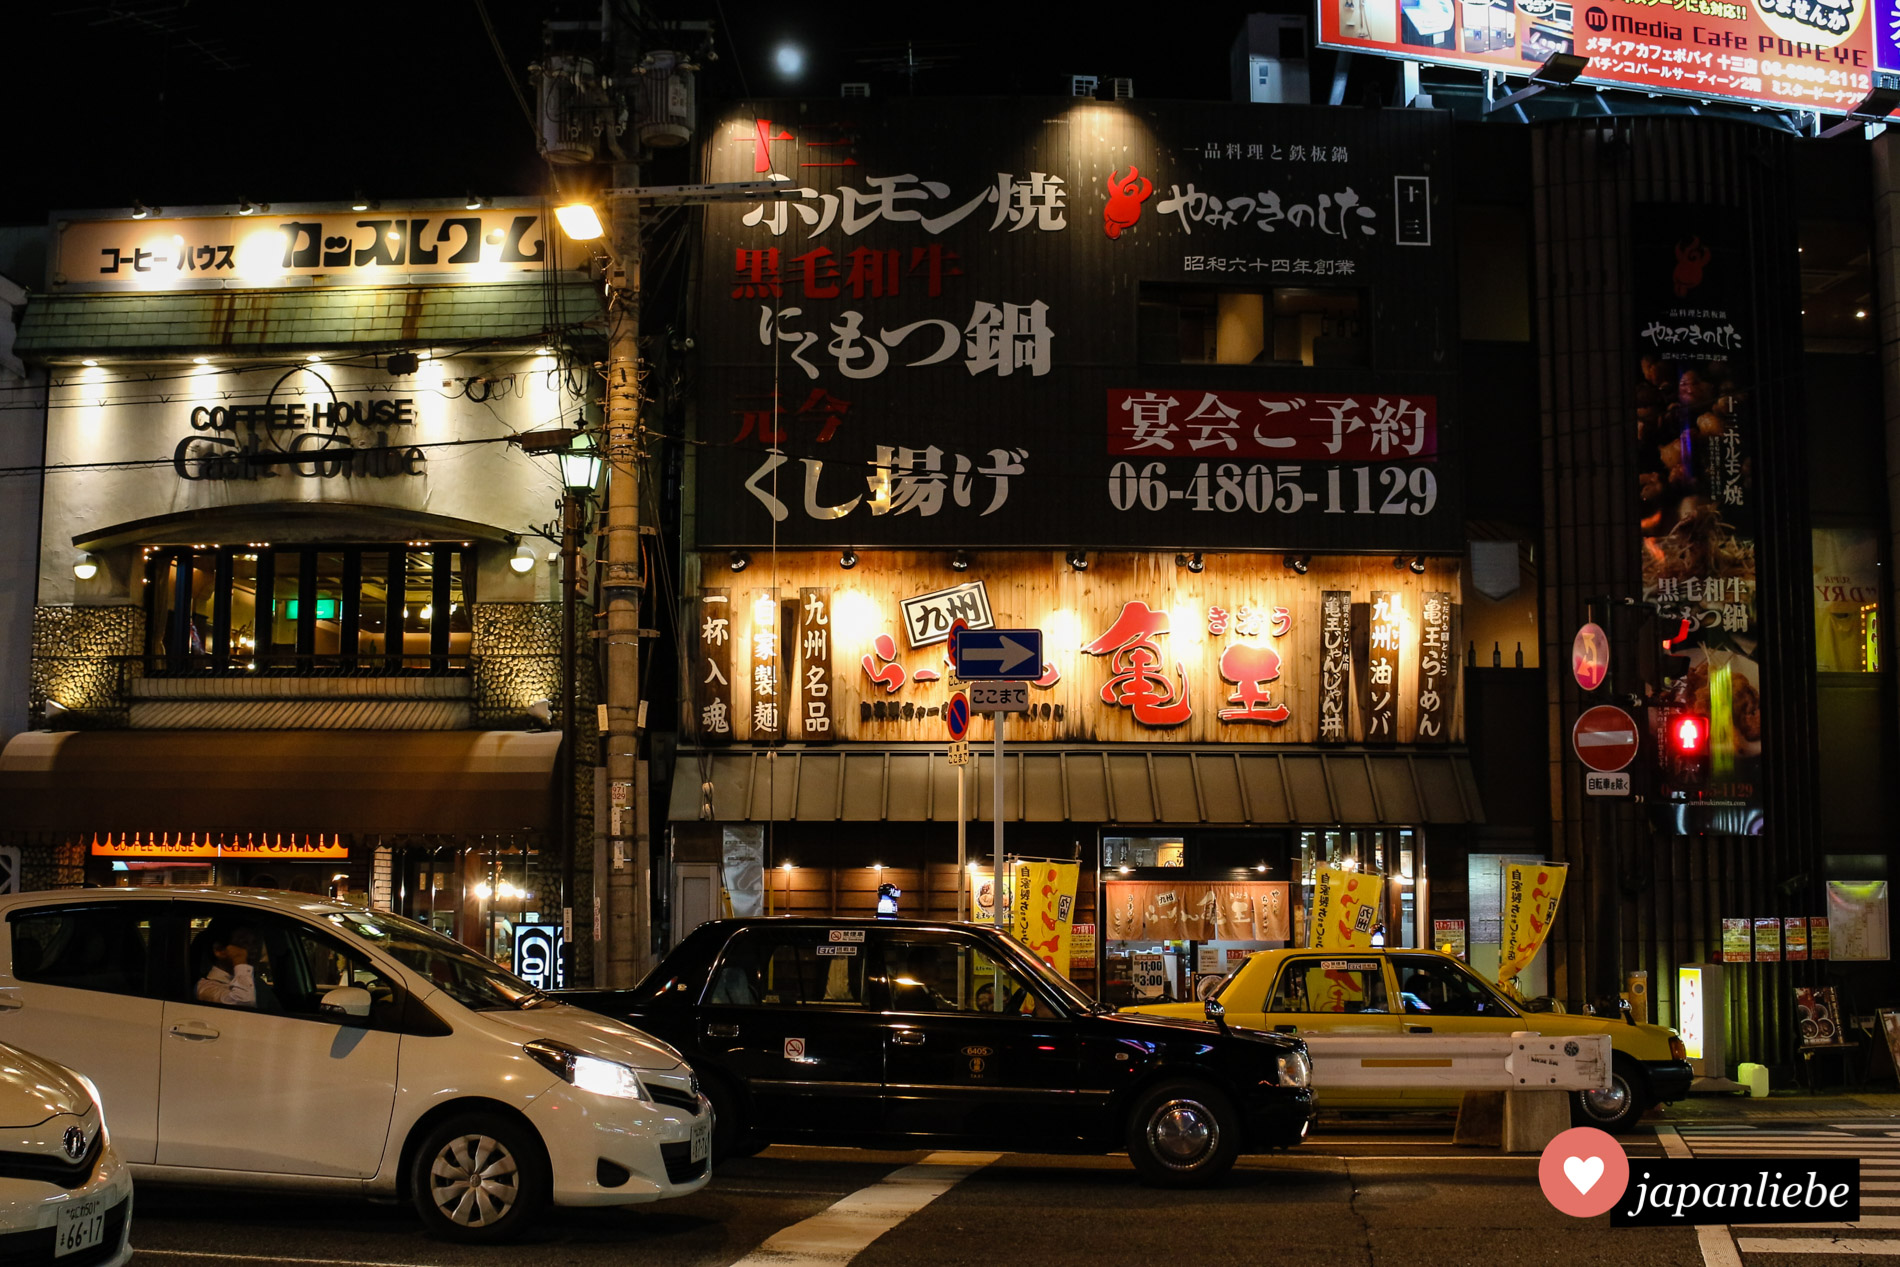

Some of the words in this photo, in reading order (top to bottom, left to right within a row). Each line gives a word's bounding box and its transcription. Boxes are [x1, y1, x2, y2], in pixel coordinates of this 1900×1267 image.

[1612, 15, 1682, 40] Media
[1693, 26, 1747, 50] Cafe
[1758, 36, 1867, 68] POPEYE
[1183, 143, 1348, 163] 一品料理と鉄板鍋
[742, 172, 1067, 238] ホルモン焼
[1157, 183, 1376, 239] やみつきのした
[1403, 186, 1421, 236] 十三
[176, 244, 235, 271] ハウス
[731, 244, 964, 299] 黒毛和牛
[1184, 256, 1355, 275] 昭和六十四年創業
[760, 299, 1055, 380] にくもつ鍋
[1640, 320, 1742, 350] やみつきのした
[191, 404, 306, 431] COFFEE
[312, 399, 414, 428] HOUSE
[1121, 391, 1427, 455] 宴会ご予約
[745, 445, 1029, 521] くし揚げ
[1108, 461, 1438, 516] 06-4805-1129
[915, 591, 981, 637] 九州
[1657, 576, 1748, 603] 黒毛和牛
[702, 595, 730, 733] 一杯入魂
[753, 594, 778, 732] 自家製麺
[804, 593, 829, 732] 九州名品
[1369, 597, 1393, 735] 九州油ソバ
[1419, 598, 1441, 737] 亀王らーめん
[973, 689, 1026, 704] ここまで
[1588, 778, 1628, 790] 自転車を除く
[1139, 975, 1162, 986] 3:00
[1140, 961, 1162, 971] 11:00
[967, 1047, 987, 1055] 6405
